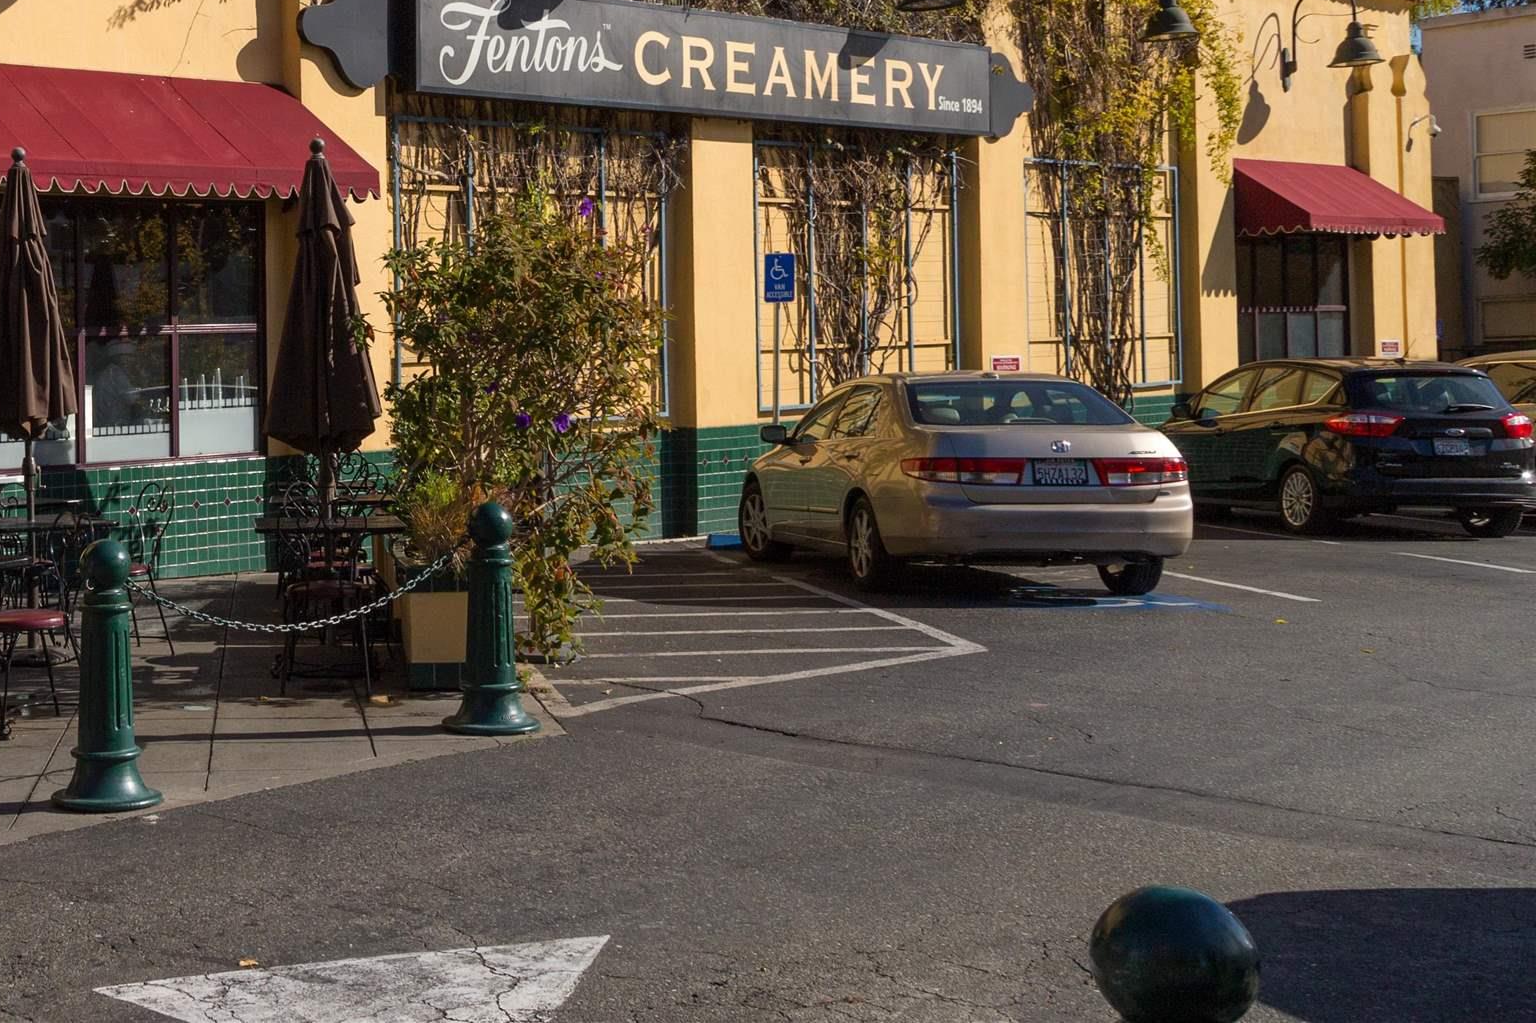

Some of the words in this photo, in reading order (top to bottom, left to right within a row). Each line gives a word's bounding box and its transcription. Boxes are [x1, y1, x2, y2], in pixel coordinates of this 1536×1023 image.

[634, 29, 944, 111] CREAMERY
[938, 96, 960, 112] Since
[962, 98, 983, 114] 1894
